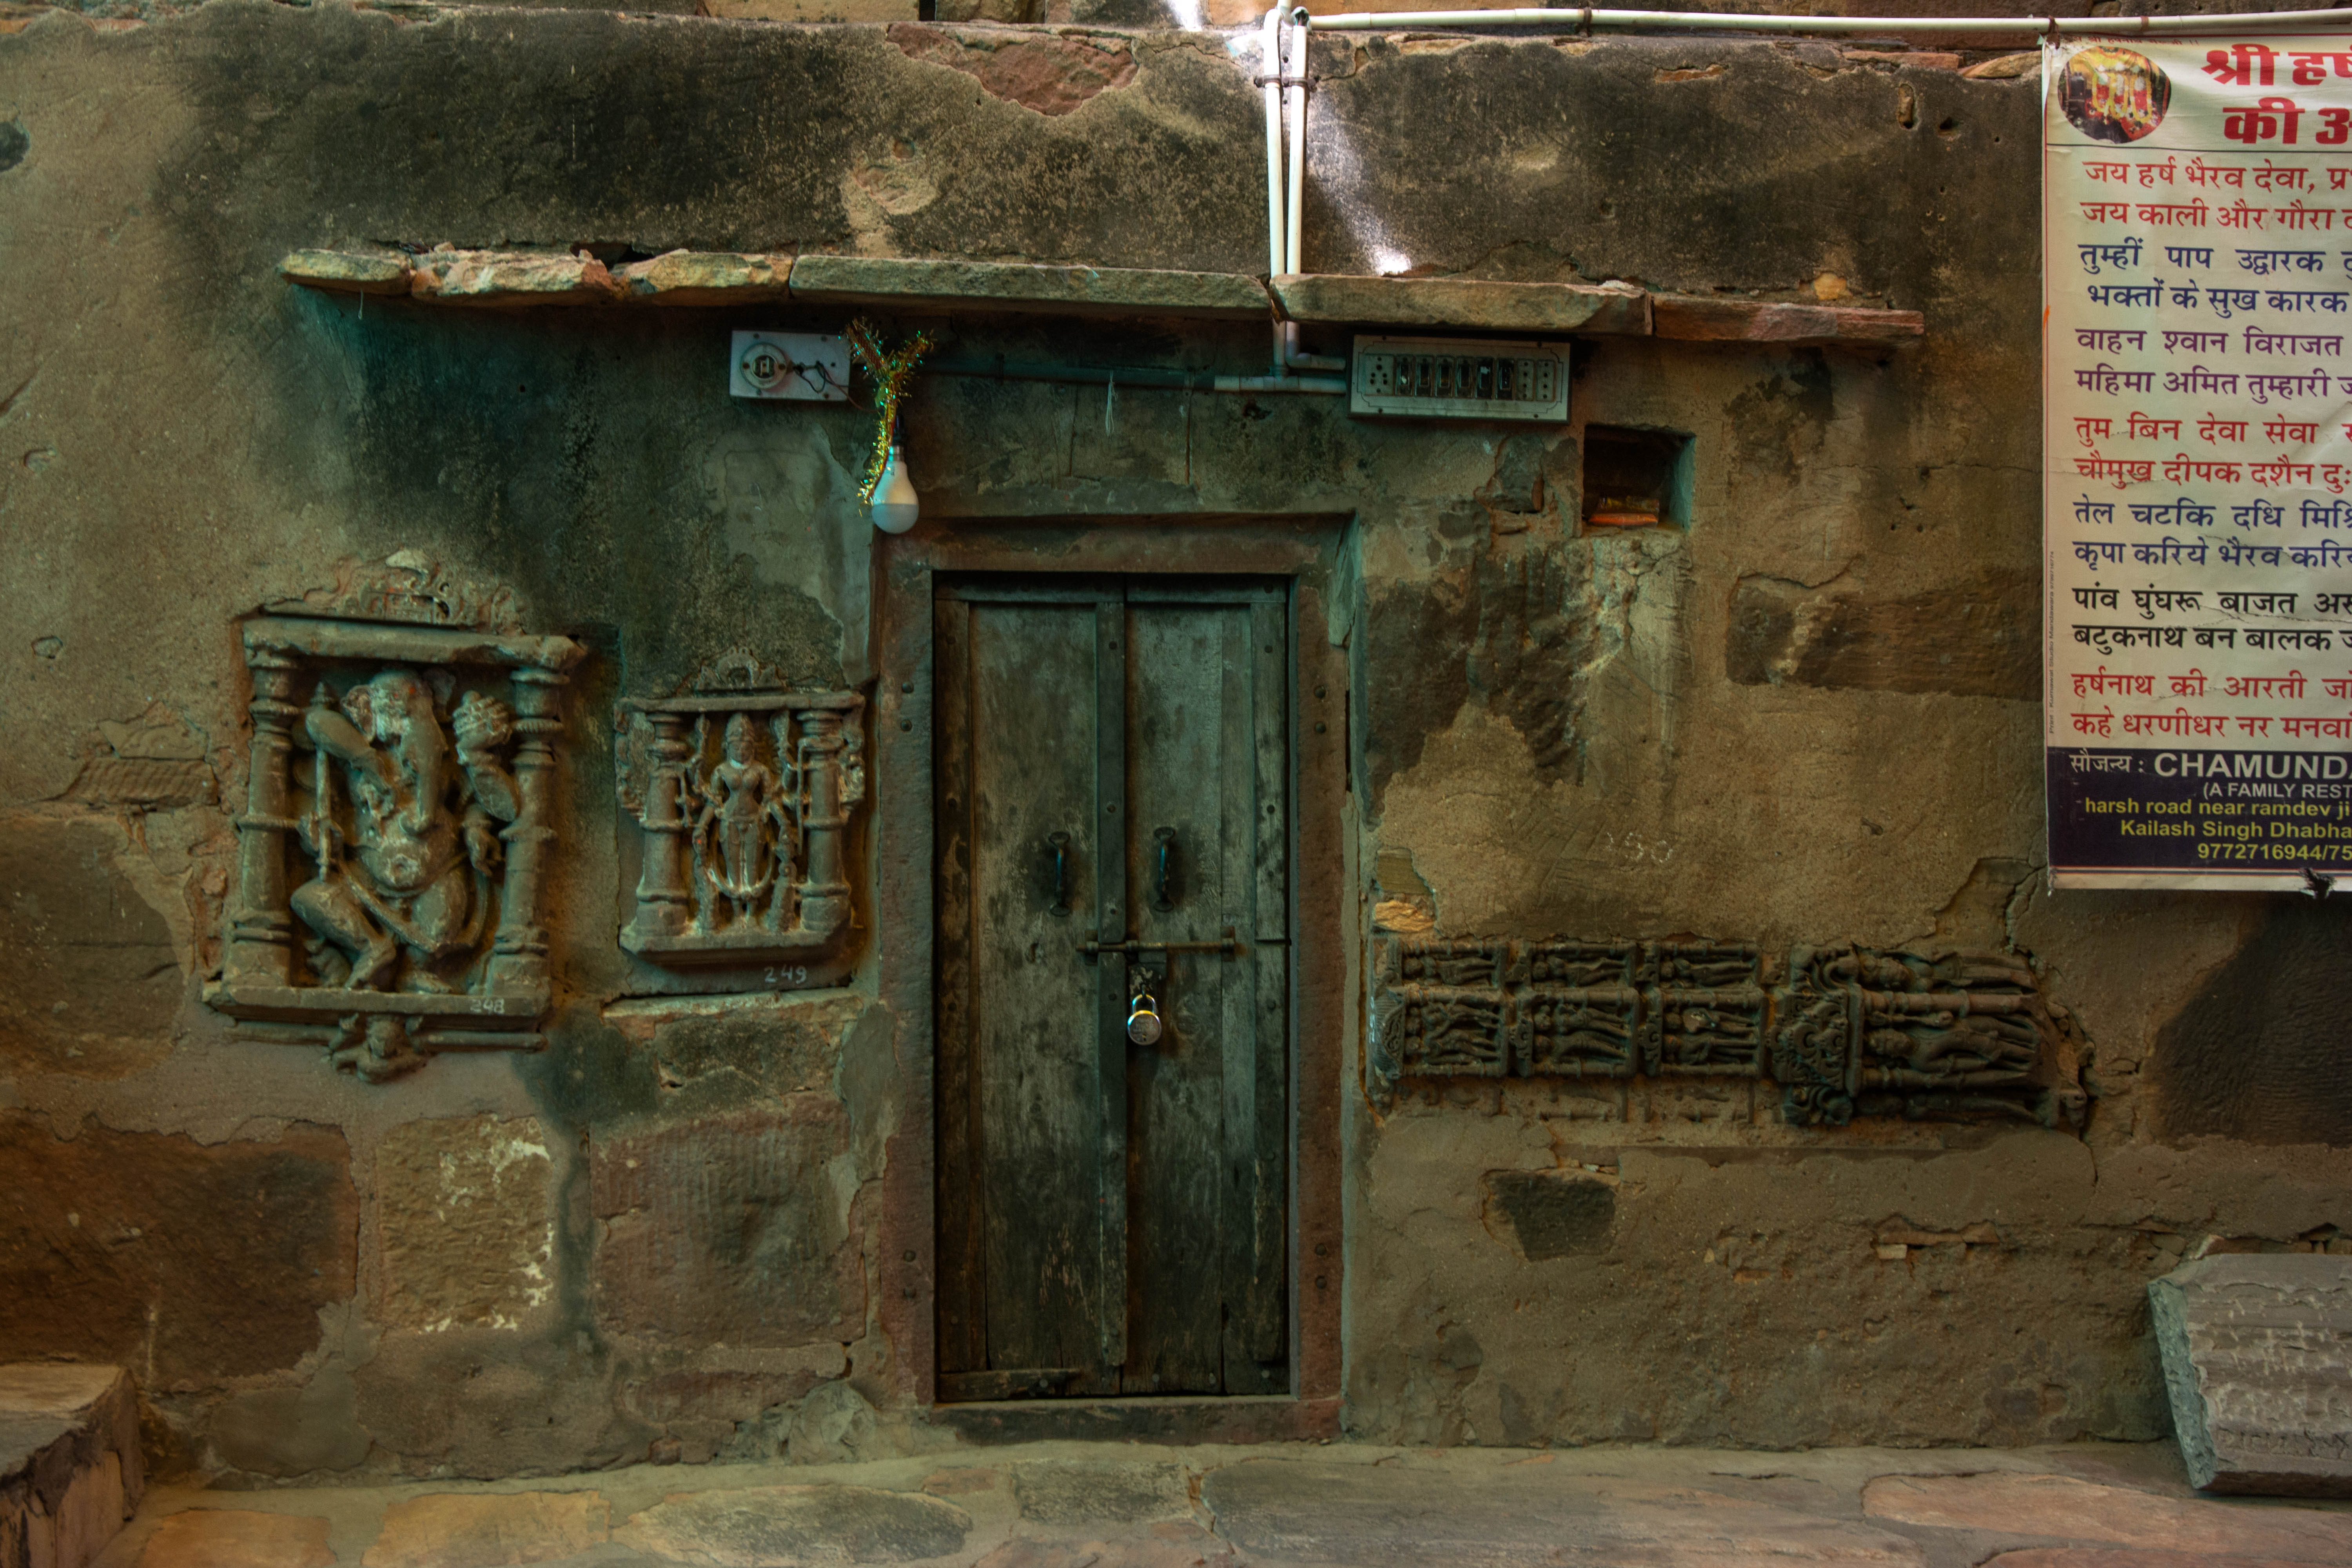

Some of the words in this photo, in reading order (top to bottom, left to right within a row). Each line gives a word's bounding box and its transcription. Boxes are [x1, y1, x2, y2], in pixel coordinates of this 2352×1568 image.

[2201, 44, 2279, 85] श्री
[2223, 97, 2305, 144] की
[2083, 162, 2130, 183] जय
[2136, 156, 2176, 188] हर्ष
[2186, 156, 2247, 188] भैरव
[2252, 159, 2314, 194] देवा,
[2327, 168, 2352, 190] प्र
[2080, 202, 2130, 223] जय
[2136, 198, 2209, 227] काली
[2217, 198, 2269, 229] और
[2274, 199, 2336, 230] गौरा
[2078, 237, 2143, 274] तुम्हीं
[2165, 247, 2214, 268] पाप
[2088, 278, 2164, 307] भक्तों
[2170, 279, 2199, 308] के
[2206, 289, 2259, 318] सुख
[2265, 291, 2349, 312] कारक
[2076, 329, 2147, 354] वाहन
[2162, 332, 2229, 354] श्वान
[2243, 326, 2343, 356] विराजत
[2074, 363, 2156, 395] महिमा
[2163, 365, 2239, 394] अमित
[2246, 368, 2331, 404] तुम्हारी
[2074, 417, 2112, 447] तुम
[2127, 411, 2183, 440] बिन
[2197, 412, 2249, 445] देवा
[2263, 414, 2320, 443] सेवा
[2074, 450, 2156, 489] चौमुख
[2161, 453, 2242, 485] दीपक
[2073, 494, 2115, 523] तेल
[2231, 499, 2285, 530] दधि
[2073, 542, 2126, 570] कृपा
[2132, 536, 2209, 565] करिये
[2219, 537, 2283, 566] भैरव
[2072, 582, 2120, 610] पांव
[2131, 583, 2203, 620] घुंघरू
[2217, 592, 2298, 614] बाजत
[2072, 625, 2188, 655] बटुकनाथ
[2192, 628, 2238, 649] बन
[2243, 629, 2333, 651] बालक
[2071, 666, 2156, 698] हर्षनाथ
[2168, 668, 2208, 697] की
[2224, 670, 2308, 699] आरती
[2071, 706, 2114, 738] कहे
[2123, 707, 2230, 737] धरणीधर
[2236, 717, 2274, 737] नर
[2069, 748, 2132, 772] सौजन्य
[2154, 753, 2352, 779] CHAMUND
[2228, 783, 2296, 797] FAMILY
[2086, 797, 2139, 813] harsh
[2147, 799, 2191, 814] road
[2200, 803, 2245, 815] near
[2252, 801, 2331, 816] ramdev
[2337, 801, 2350, 820] ji
[2122, 820, 2195, 836] Kailash
[2203, 821, 2262, 840] Singh
[2270, 822, 2352, 838] Dhabha
[764, 965, 807, 984] 249
[470, 998, 505, 1015] 248
